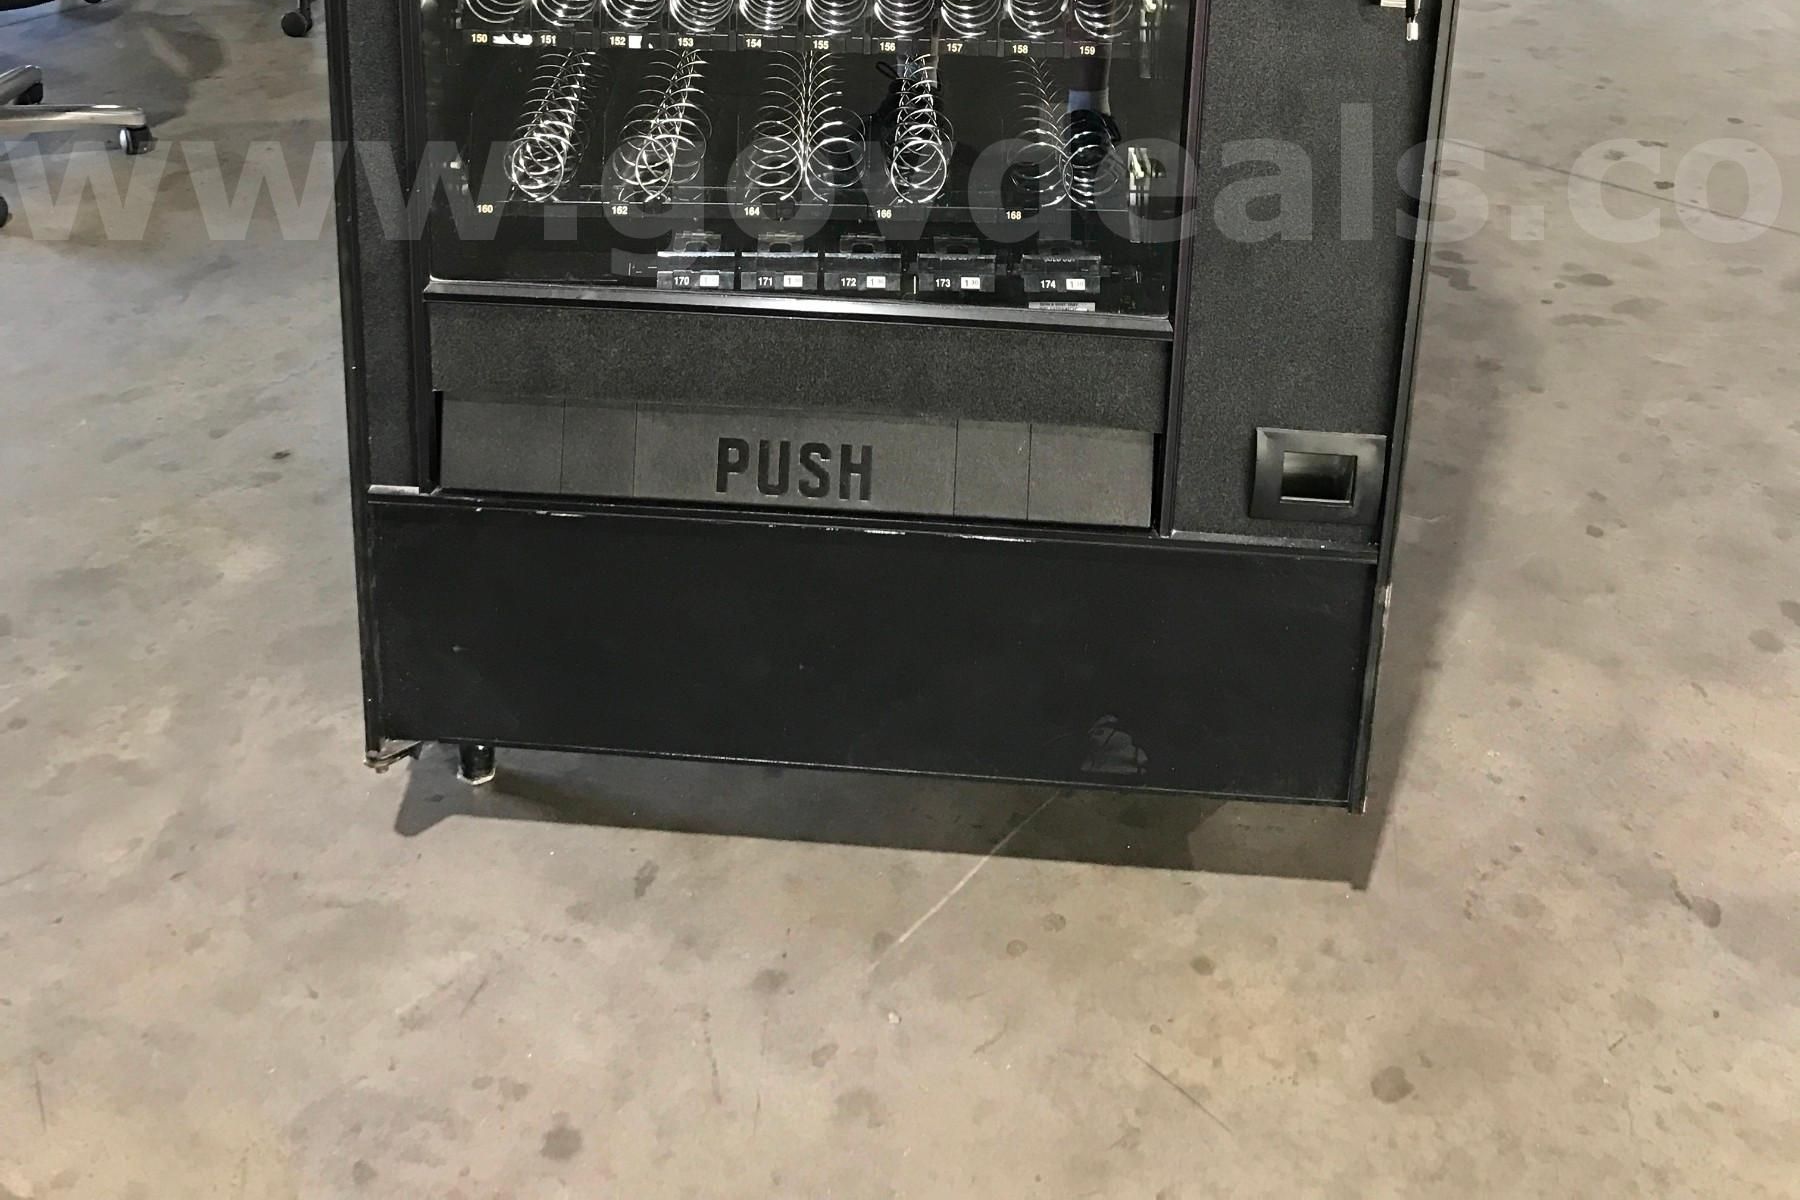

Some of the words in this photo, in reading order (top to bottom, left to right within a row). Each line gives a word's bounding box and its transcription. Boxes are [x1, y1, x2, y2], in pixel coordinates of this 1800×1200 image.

[471, 33, 488, 43] 150
[540, 34, 557, 46] 151
[609, 36, 626, 46] 152
[678, 37, 694, 48] 153
[745, 38, 762, 48] 154
[813, 39, 829, 50] 155
[880, 41, 896, 52] 156
[947, 42, 963, 53] 157
[1012, 44, 1029, 54] 158
[1079, 45, 1096, 56] 159
[477, 204, 494, 214] 160
[611, 205, 628, 215] 162
[744, 206, 760, 216] 164
[876, 209, 892, 219] 166
[1006, 210, 1022, 220] 168
[674, 276, 690, 286] 170
[758, 276, 773, 286] 171
[840, 277, 857, 287] 172
[935, 278, 951, 288] 173
[1040, 279, 1056, 289] 174
[716, 437, 873, 501] PUSH
